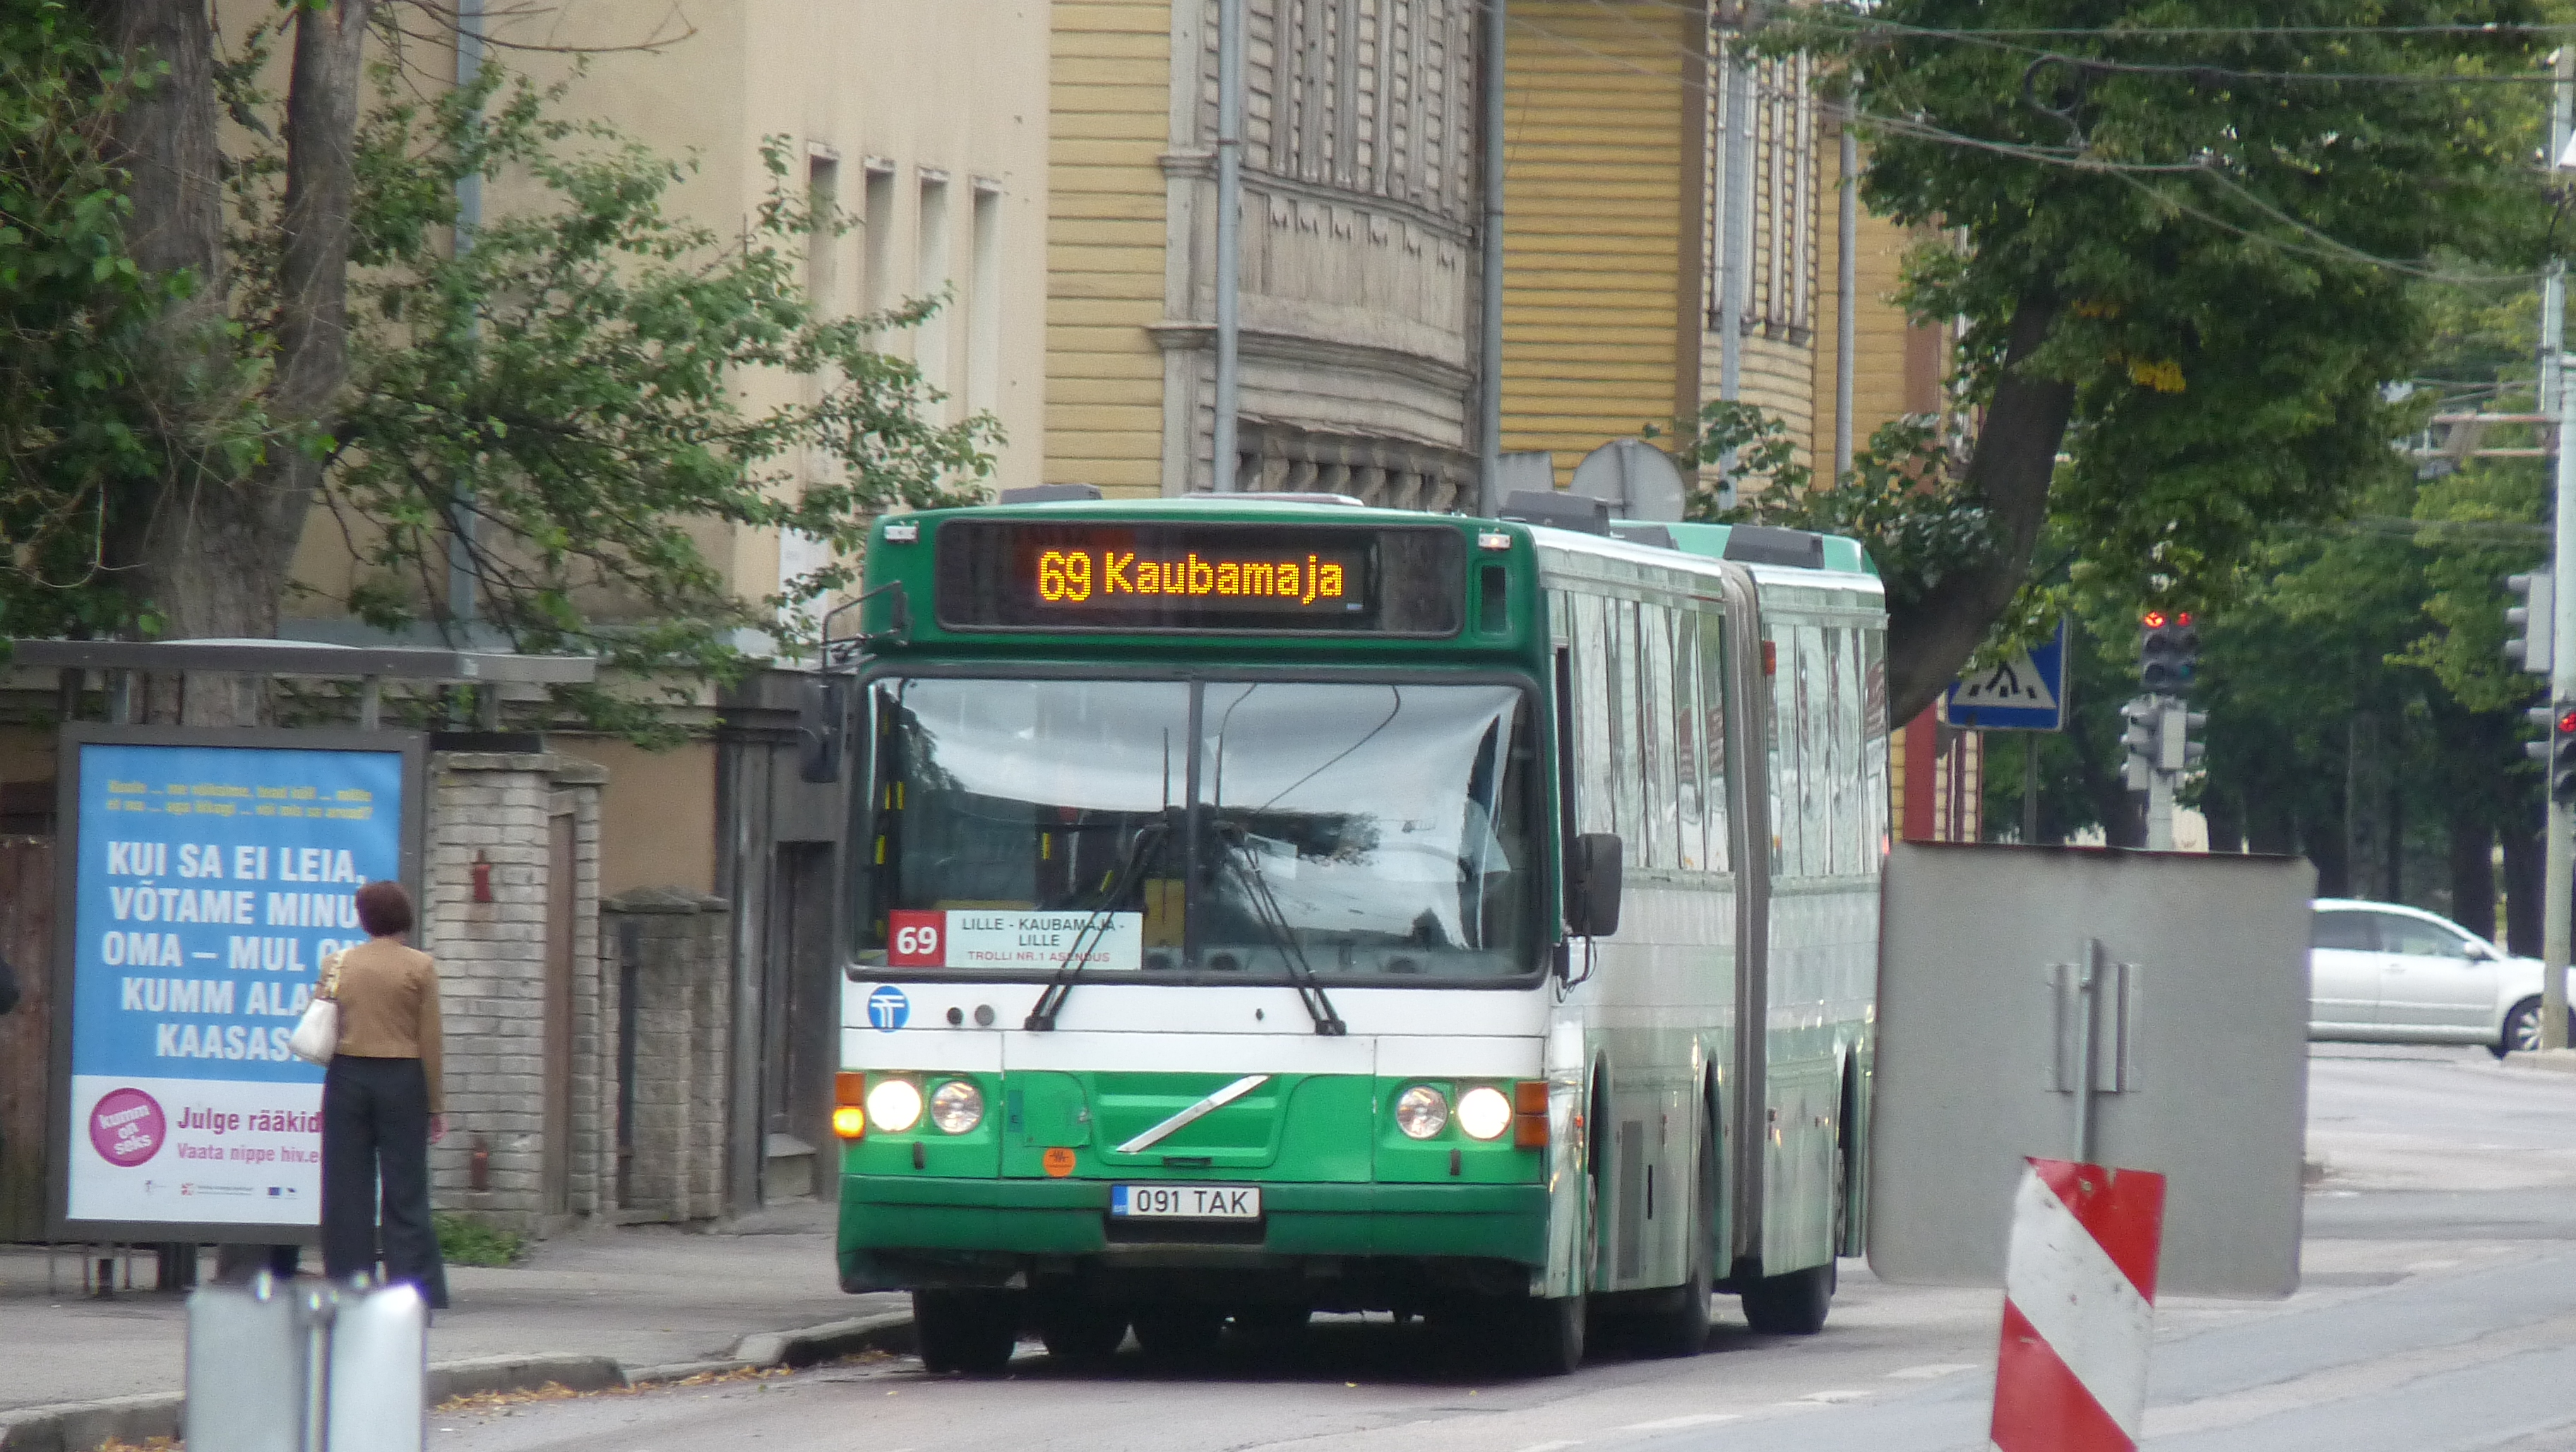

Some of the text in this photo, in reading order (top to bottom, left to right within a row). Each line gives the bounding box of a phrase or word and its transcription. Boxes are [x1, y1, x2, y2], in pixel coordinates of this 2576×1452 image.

[1039, 549, 1344, 605] 69 Kaubamaja
[107, 841, 366, 888] KUI SA EI LEIA,
[109, 880, 361, 929] VÕTAME MINU
[962, 918, 1004, 931] LILLE
[1018, 918, 1116, 932] KAUBAMAJA
[102, 931, 184, 968] OMA
[228, 935, 306, 972] MUL
[897, 927, 938, 955] 69
[1018, 934, 1061, 947] LILLE
[967, 951, 1013, 961] TROLLI
[1049, 952, 1111, 963] ASENDUS
[121, 977, 317, 1016] KUMM ALA
[177, 1107, 324, 1135] Julge rääkid
[177, 1143, 319, 1165] Vaata nippe hiv.e
[1137, 1189, 1249, 1214] 091 TAK
